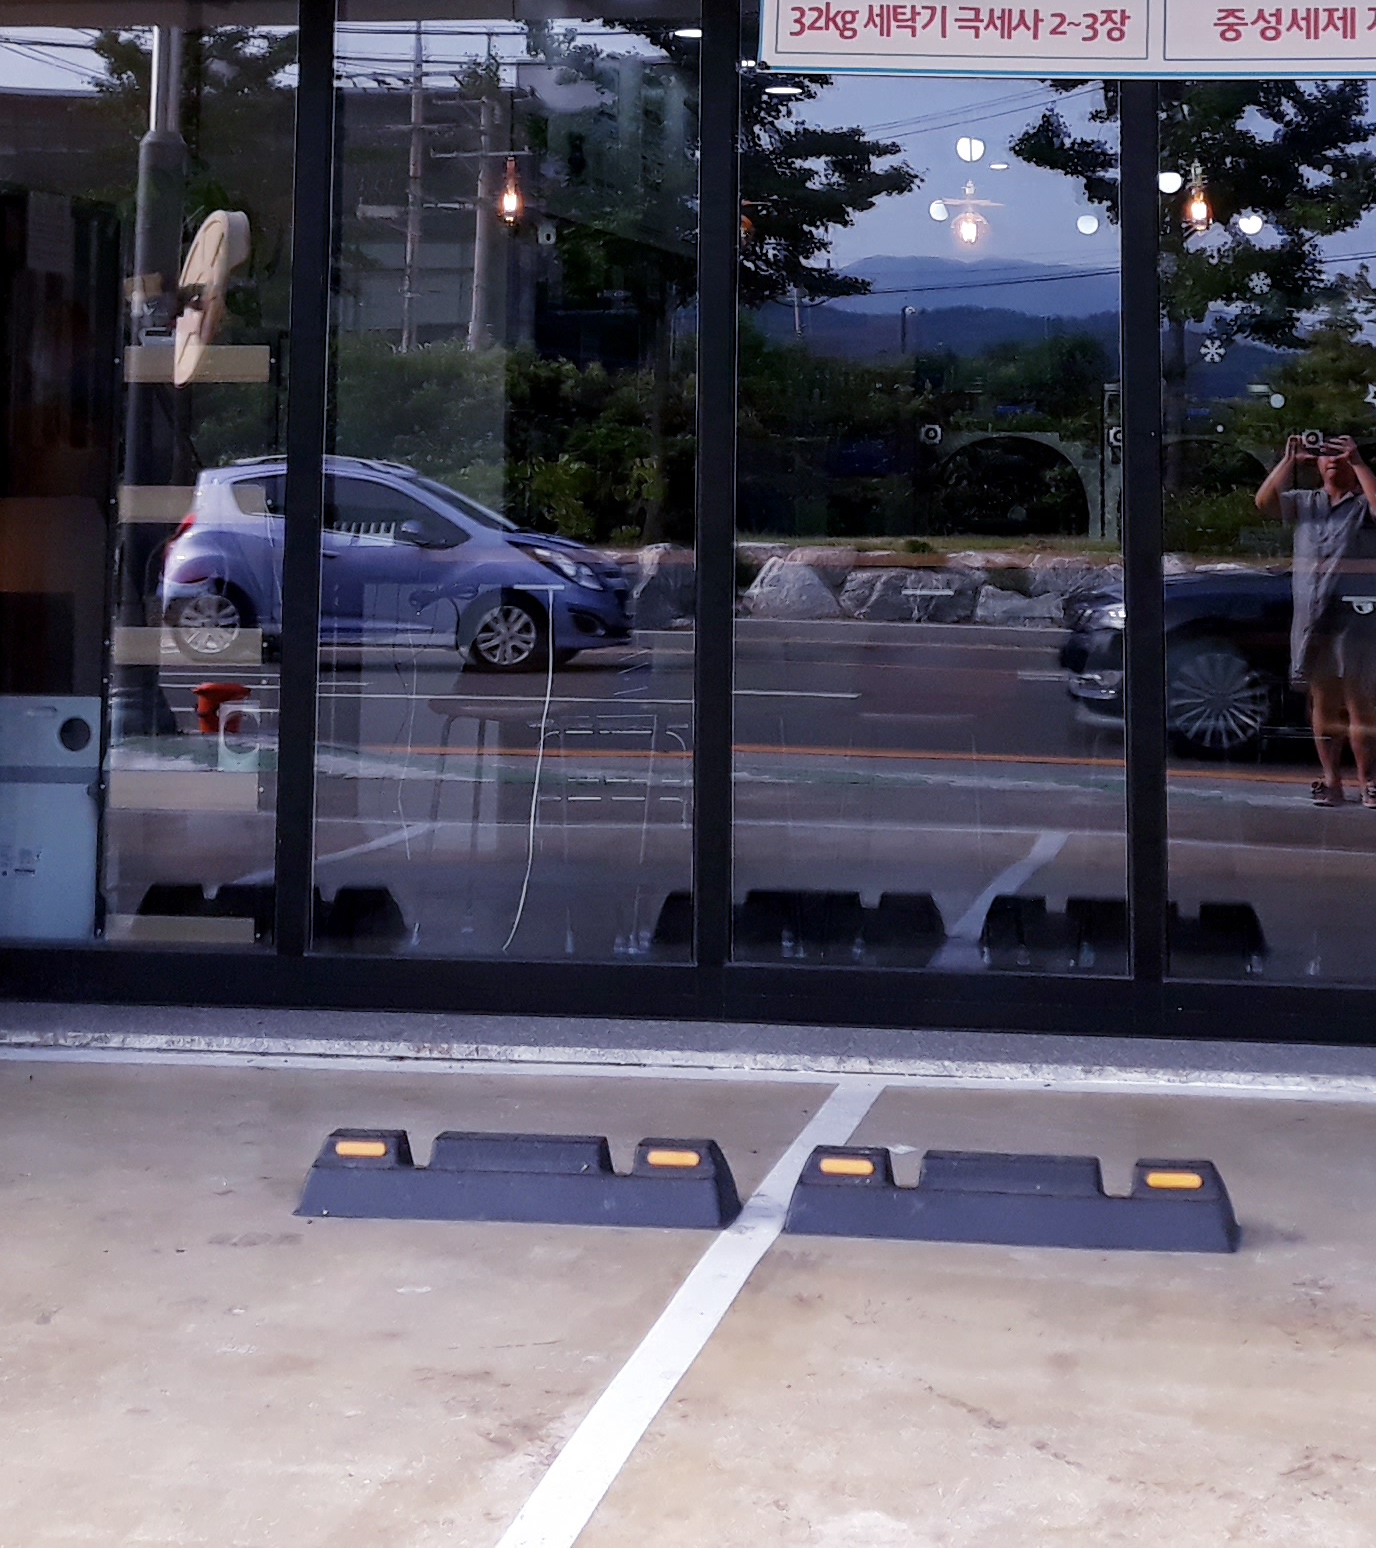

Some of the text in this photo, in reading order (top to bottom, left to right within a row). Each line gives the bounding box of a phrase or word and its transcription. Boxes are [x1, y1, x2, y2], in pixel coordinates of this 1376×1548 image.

[789, 1, 1131, 42] 32kg 세탁기 극세사 2~3장
[1212, 7, 1357, 42] 중성세제
